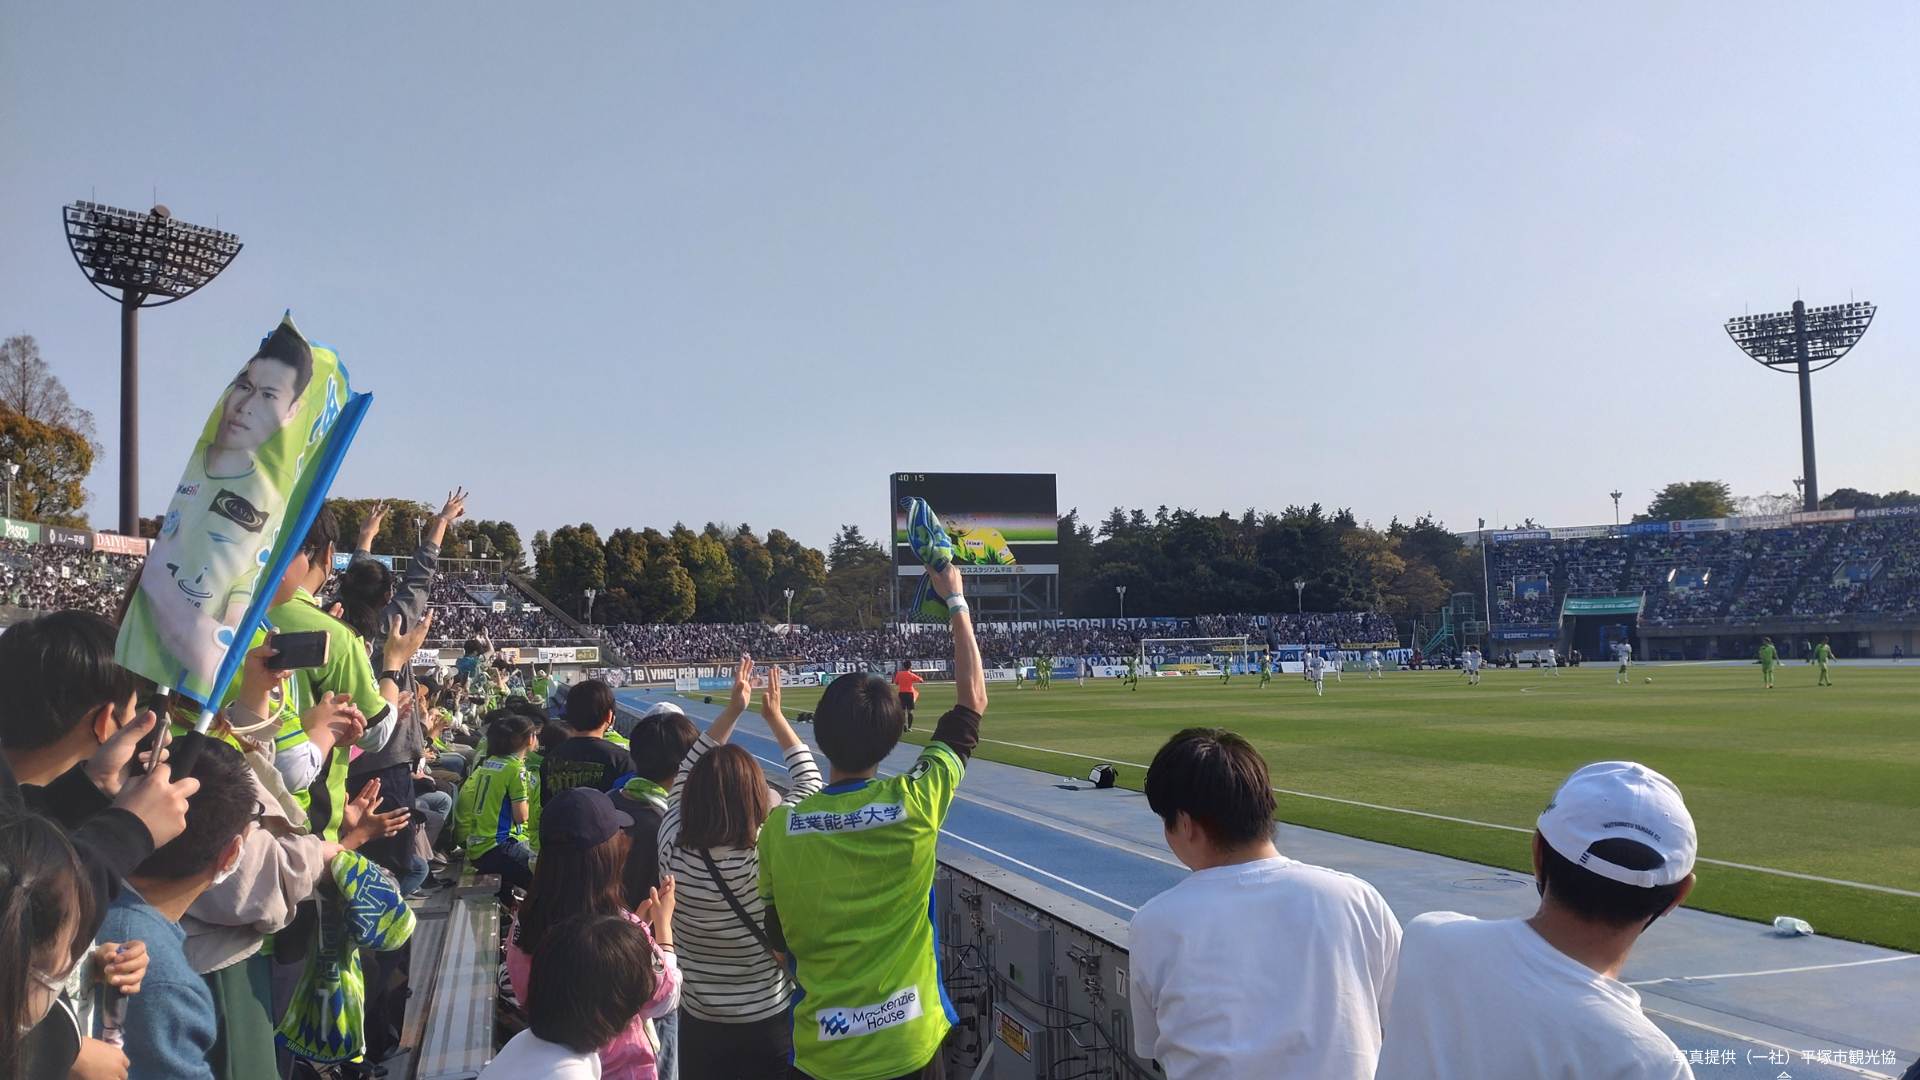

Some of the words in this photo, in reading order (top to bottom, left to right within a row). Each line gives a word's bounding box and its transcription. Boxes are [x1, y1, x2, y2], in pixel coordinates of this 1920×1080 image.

[96, 534, 129, 548] DAIYU
[633, 669, 645, 681] 19
[650, 668, 677, 680] VINCI
[678, 667, 696, 679] PER
[698, 667, 714, 678] NOI
[721, 667, 732, 677] 91
[789, 805, 902, 832] 産業能率大学
[1117, 969, 1125, 993] 7
[867, 1009, 905, 1031] House
